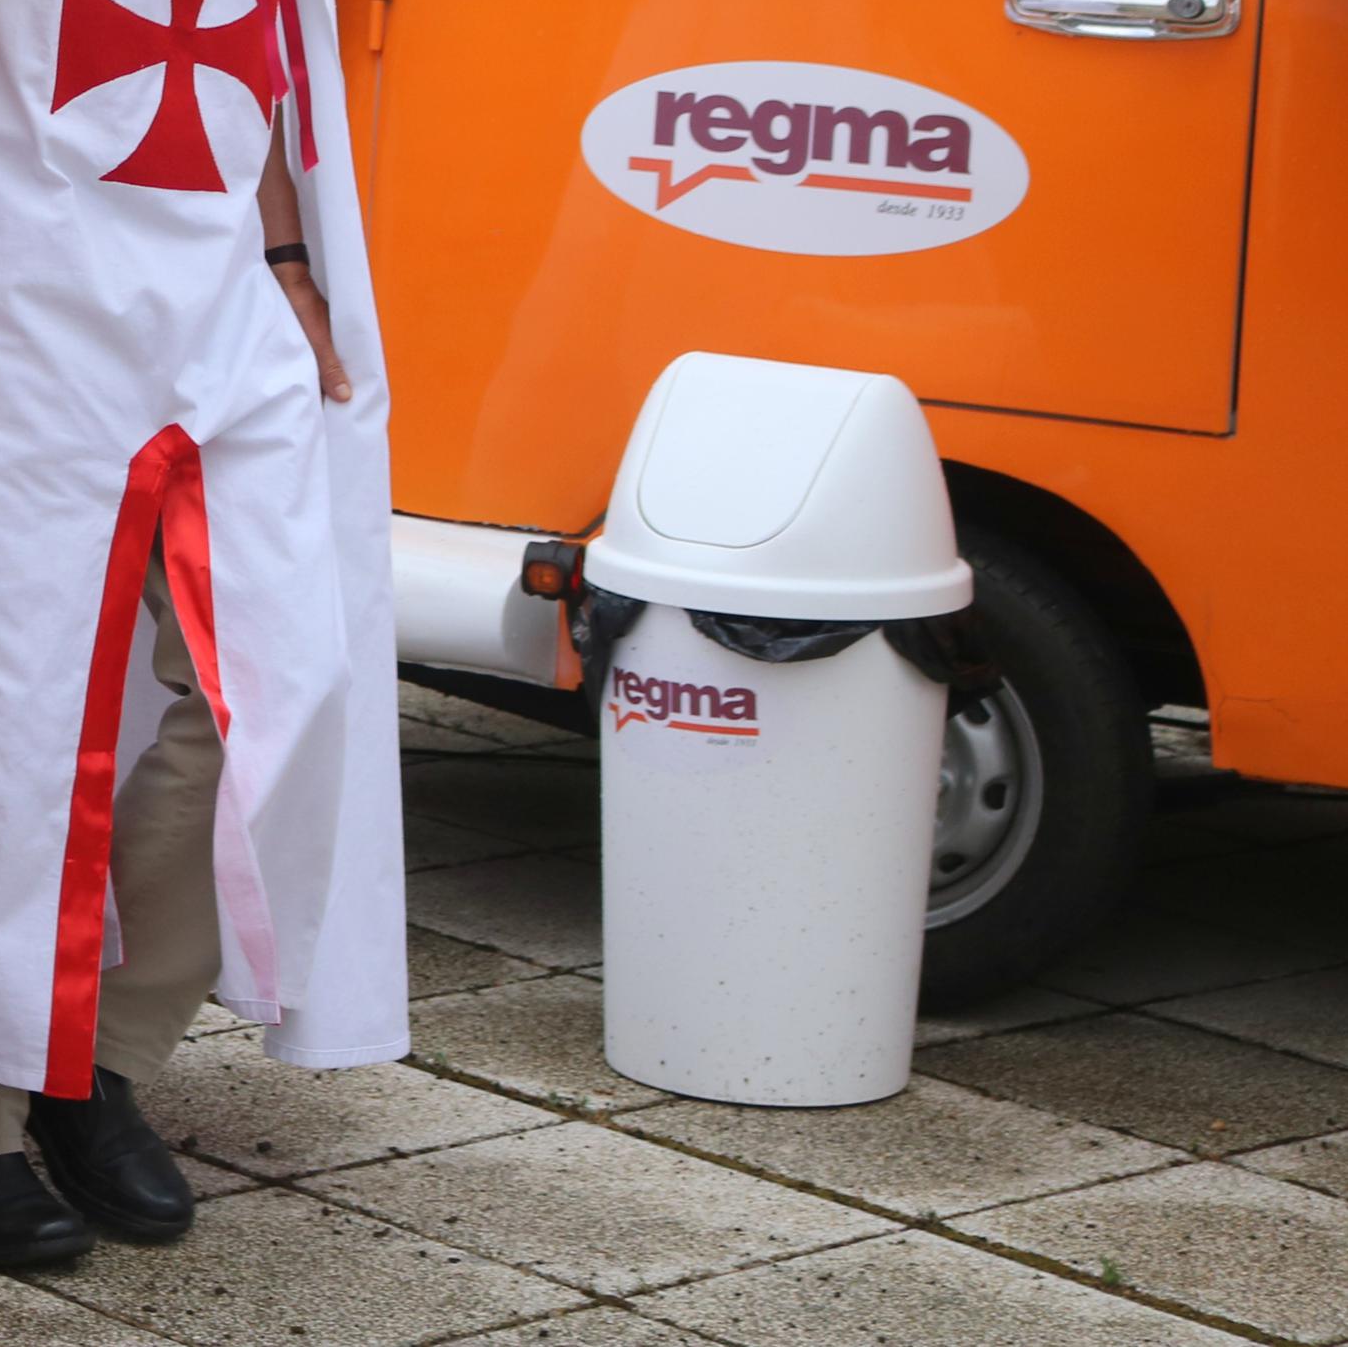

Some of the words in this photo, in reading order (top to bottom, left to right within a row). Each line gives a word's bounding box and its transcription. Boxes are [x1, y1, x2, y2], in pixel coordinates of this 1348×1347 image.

[653, 90, 972, 176] regma
[876, 199, 918, 217] desde
[612, 666, 758, 721] regma
